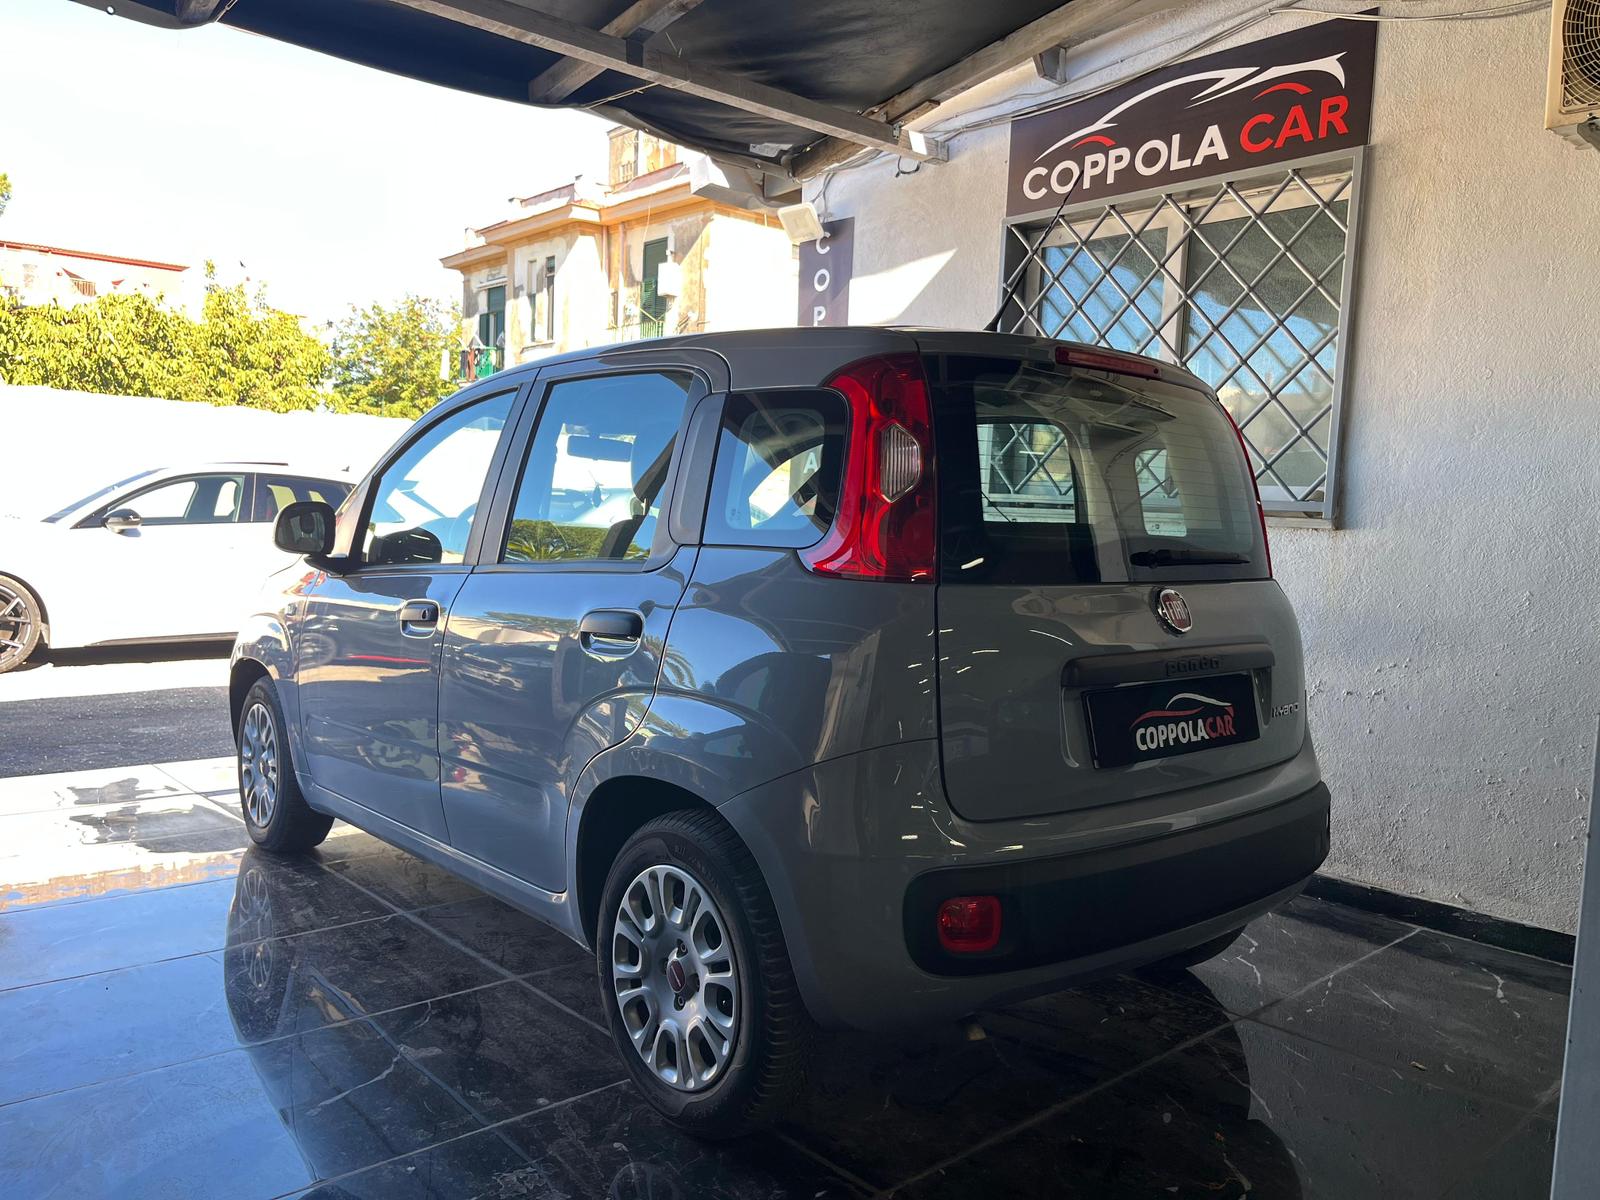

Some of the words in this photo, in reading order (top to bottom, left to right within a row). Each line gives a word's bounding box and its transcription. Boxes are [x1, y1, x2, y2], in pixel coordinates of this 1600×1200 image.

[1022, 124, 1229, 200] COPPOLA
[1239, 95, 1349, 153] CAR
[1165, 600, 1188, 620] FIAT
